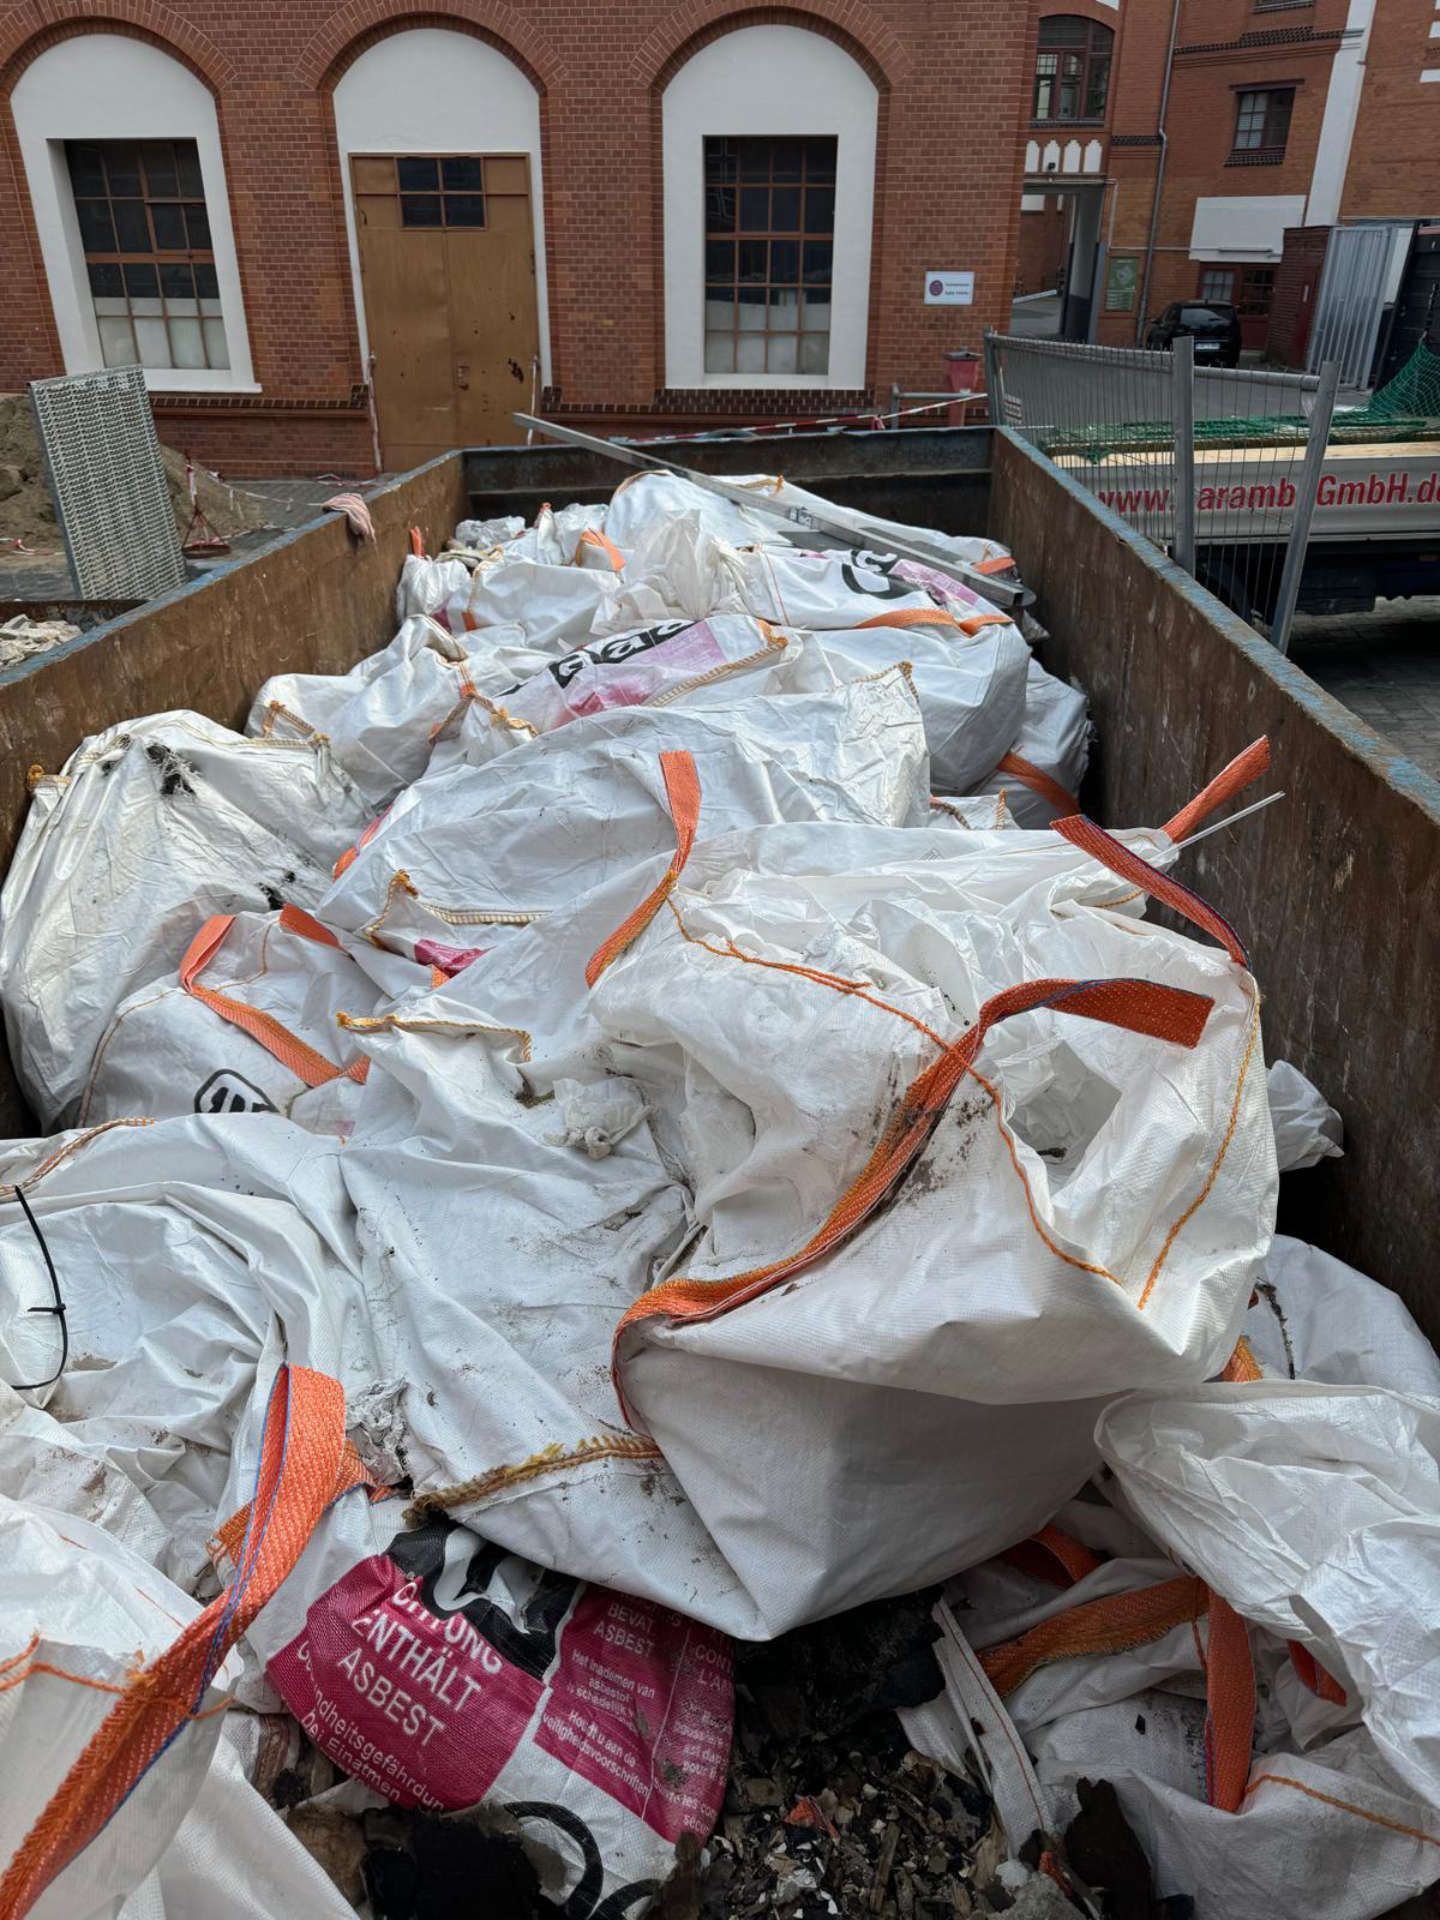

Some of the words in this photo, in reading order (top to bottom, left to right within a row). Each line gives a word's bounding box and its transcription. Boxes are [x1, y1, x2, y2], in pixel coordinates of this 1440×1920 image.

[607, 1601, 656, 1633] BEVAT
[592, 1619, 656, 1659] ASBEST
[337, 1647, 448, 1748] ASBEST
[636, 1682, 656, 1700] van
[301, 1708, 325, 1742] bei
[326, 1738, 402, 1802] Einatmen
[605, 1739, 624, 1758] aan
[623, 1751, 637, 1768] de
